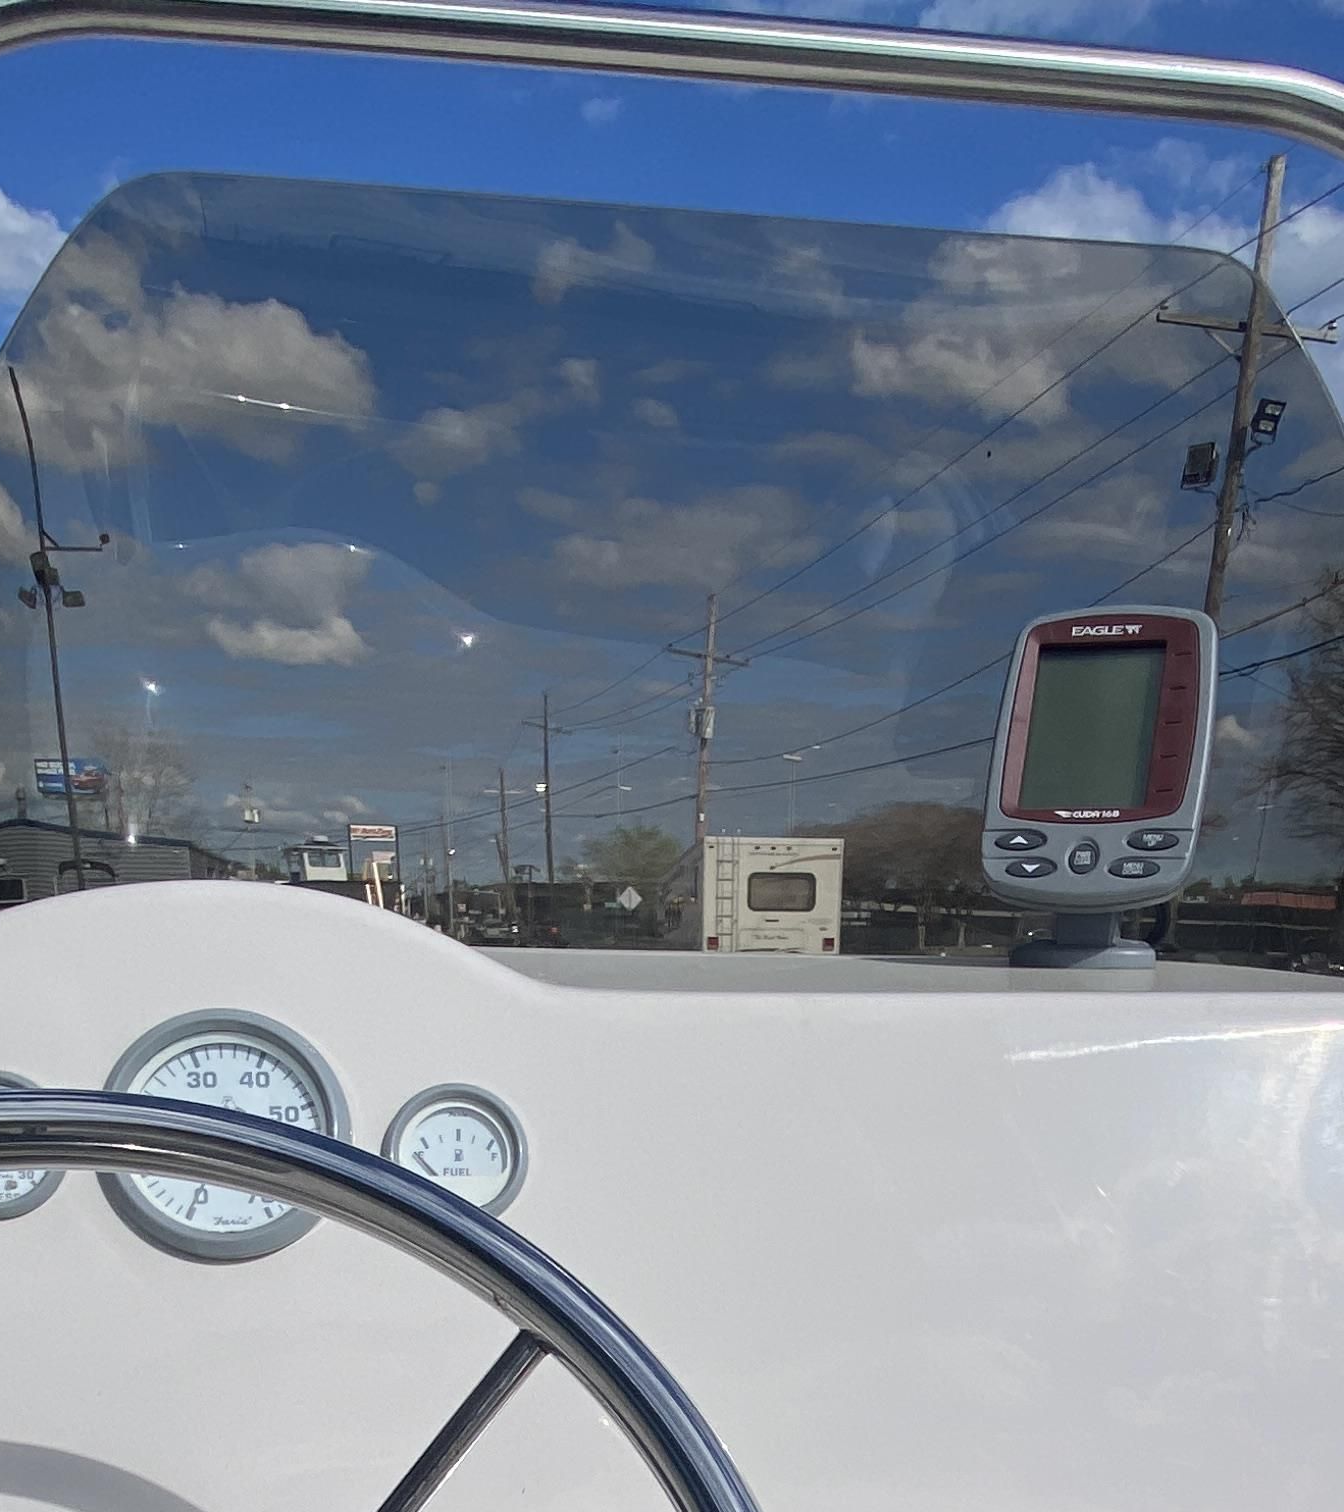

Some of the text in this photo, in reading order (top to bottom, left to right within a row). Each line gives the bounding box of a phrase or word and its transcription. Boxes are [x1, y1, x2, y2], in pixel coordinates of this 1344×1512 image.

[1072, 625, 1124, 637] EAGLE
[187, 1071, 218, 1089] 30
[239, 1071, 270, 1089] 40
[269, 1105, 300, 1123] 50
[491, 1152, 499, 1162] F
[18, 1170, 35, 1180] 30
[443, 1167, 472, 1177] FUEL
